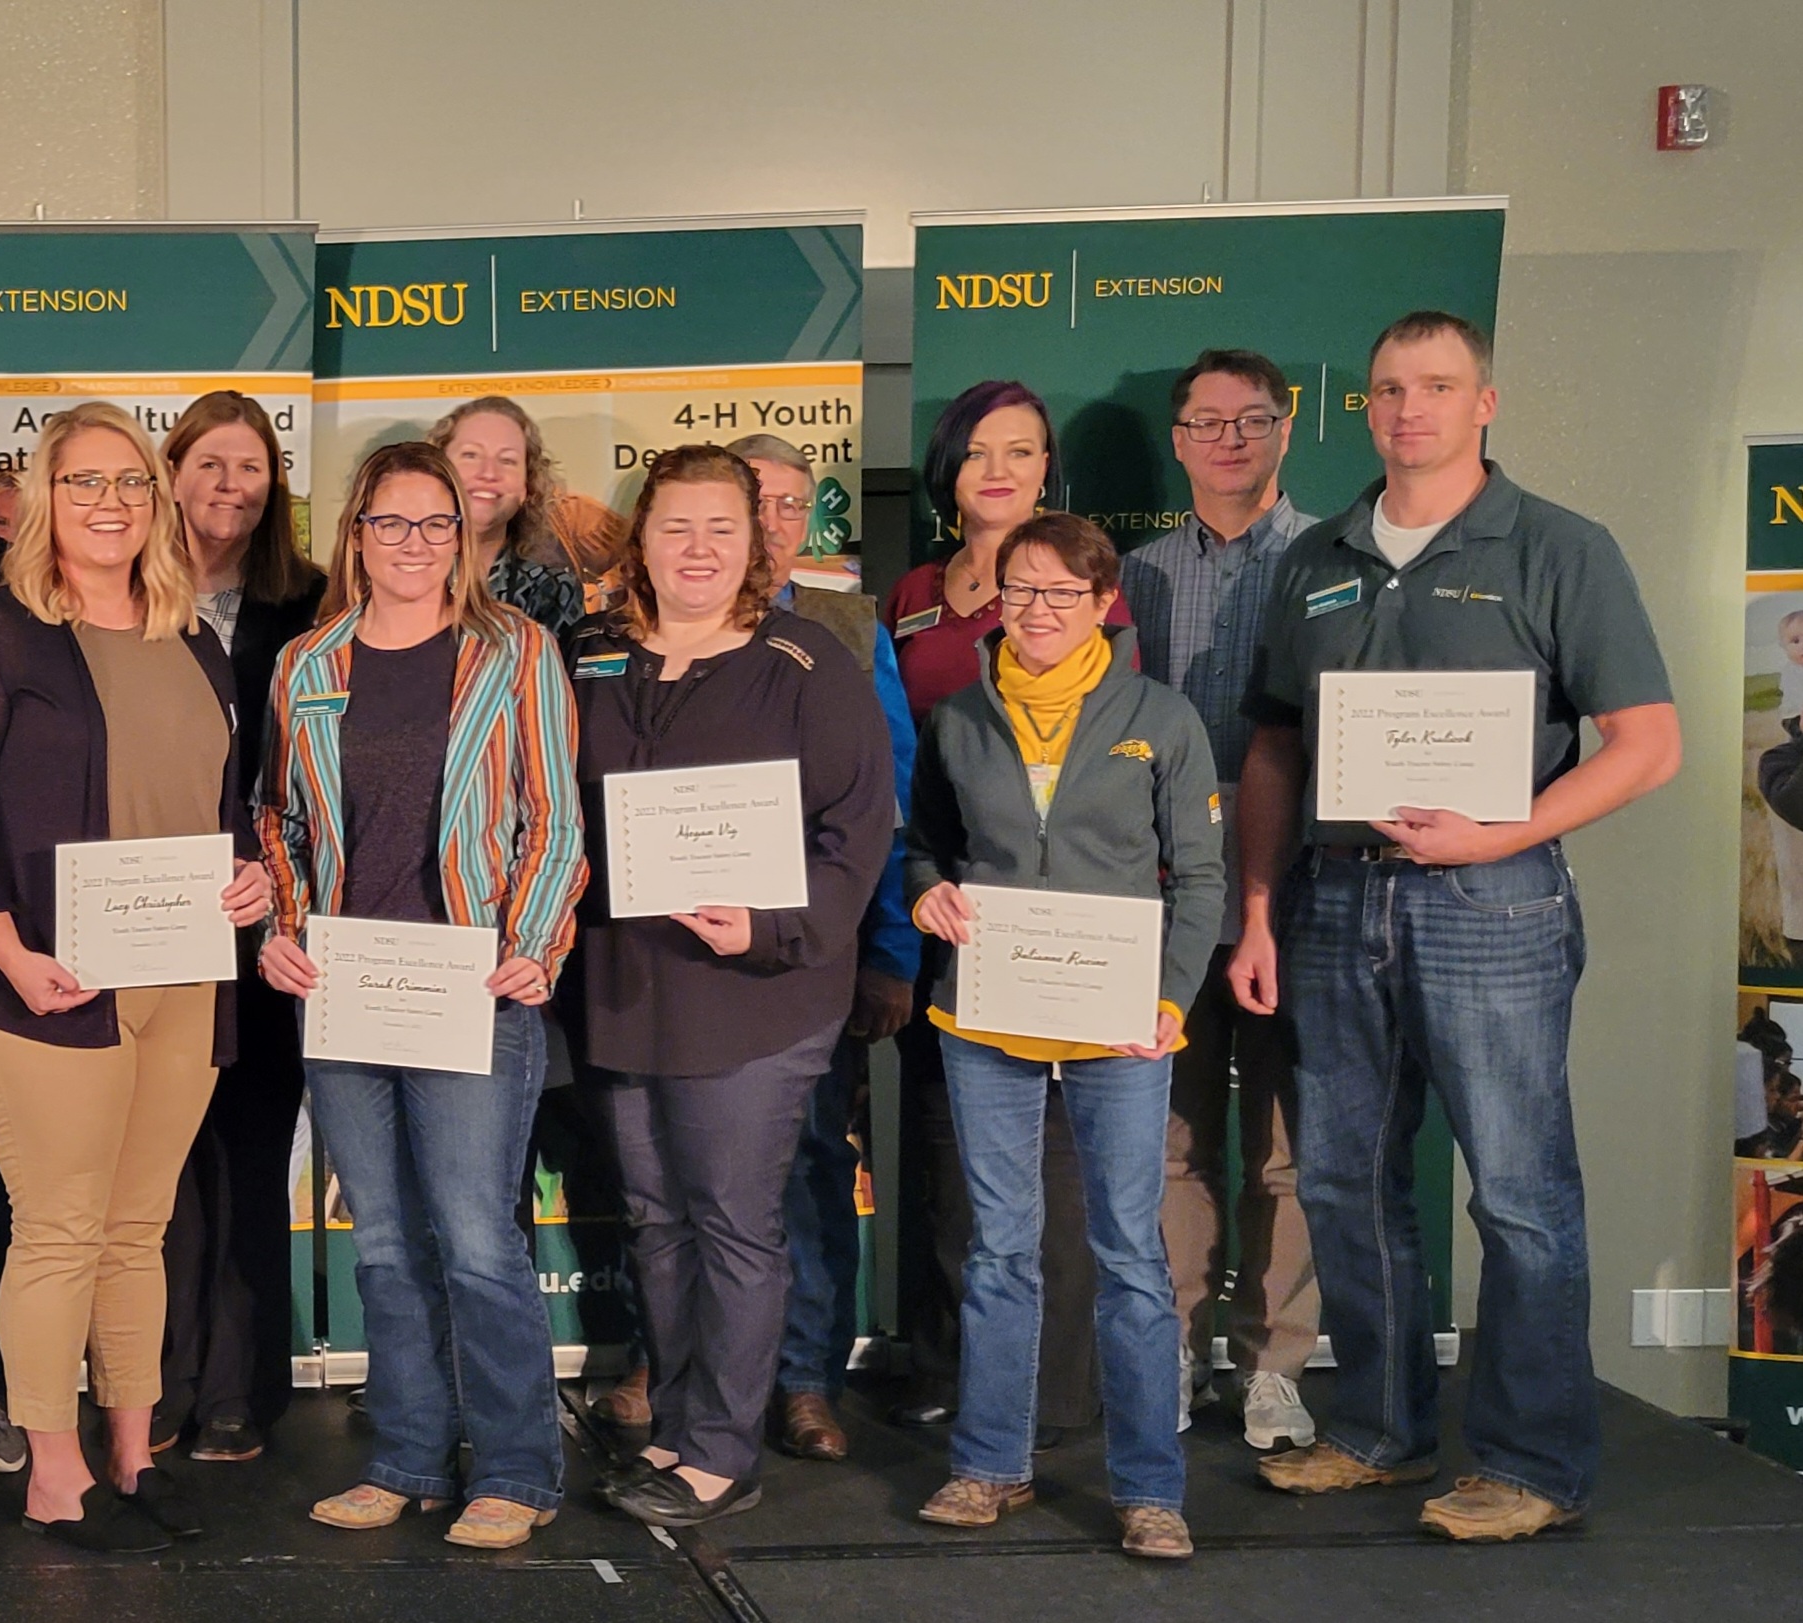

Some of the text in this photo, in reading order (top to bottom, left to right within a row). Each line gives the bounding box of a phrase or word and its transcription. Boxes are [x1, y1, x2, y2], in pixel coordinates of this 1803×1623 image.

[935, 272, 1223, 310] NDSU EXTENSION
[324, 283, 677, 329] NDSU EXTENSION
[140, 380, 179, 391] LIVES
[439, 381, 512, 395] EXTENDING
[515, 378, 601, 391] KNOWLEDGE
[674, 398, 853, 431] 4-H Youth
[358, 974, 394, 989] Sarah
